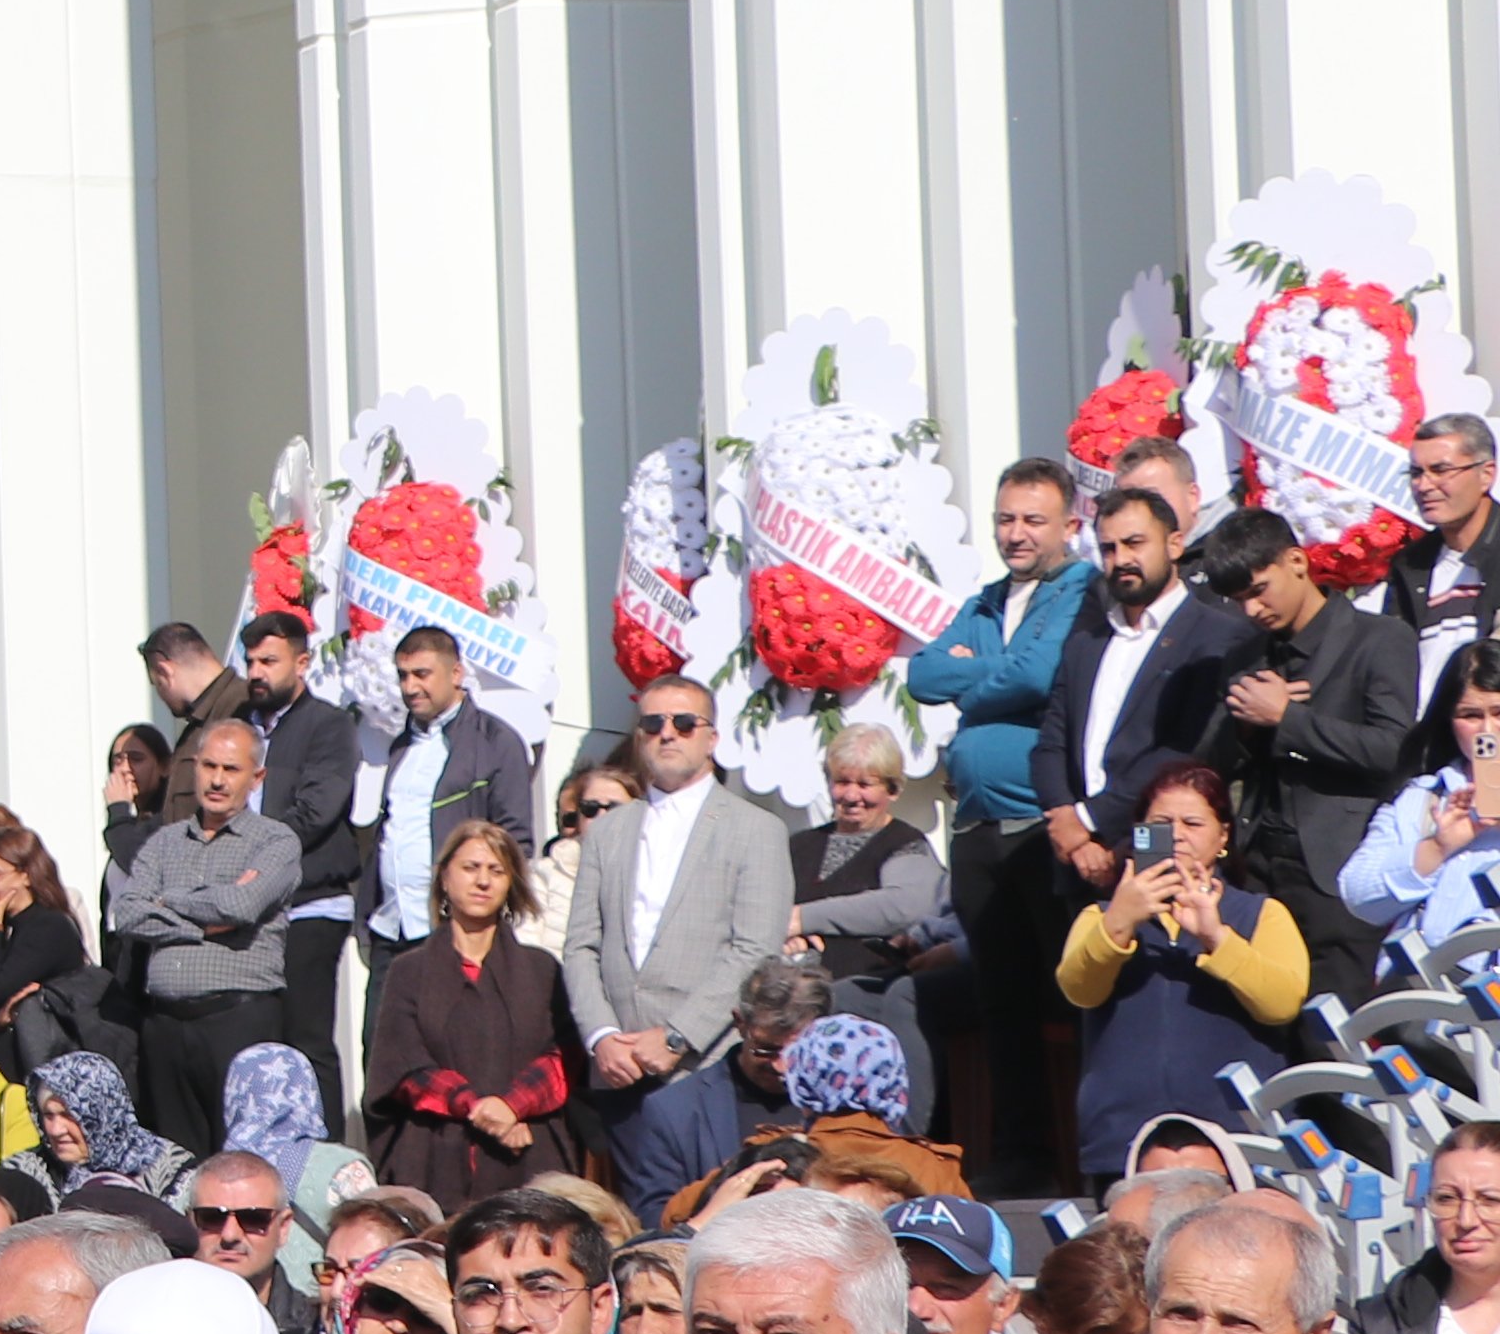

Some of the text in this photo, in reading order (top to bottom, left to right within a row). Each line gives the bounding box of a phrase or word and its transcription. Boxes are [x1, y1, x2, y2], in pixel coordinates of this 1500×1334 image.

[1304, 423, 1414, 513] MİMA
[754, 488, 842, 569] PLASTİK
[360, 588, 442, 631] KAYNA
[405, 583, 528, 656] PINARI
